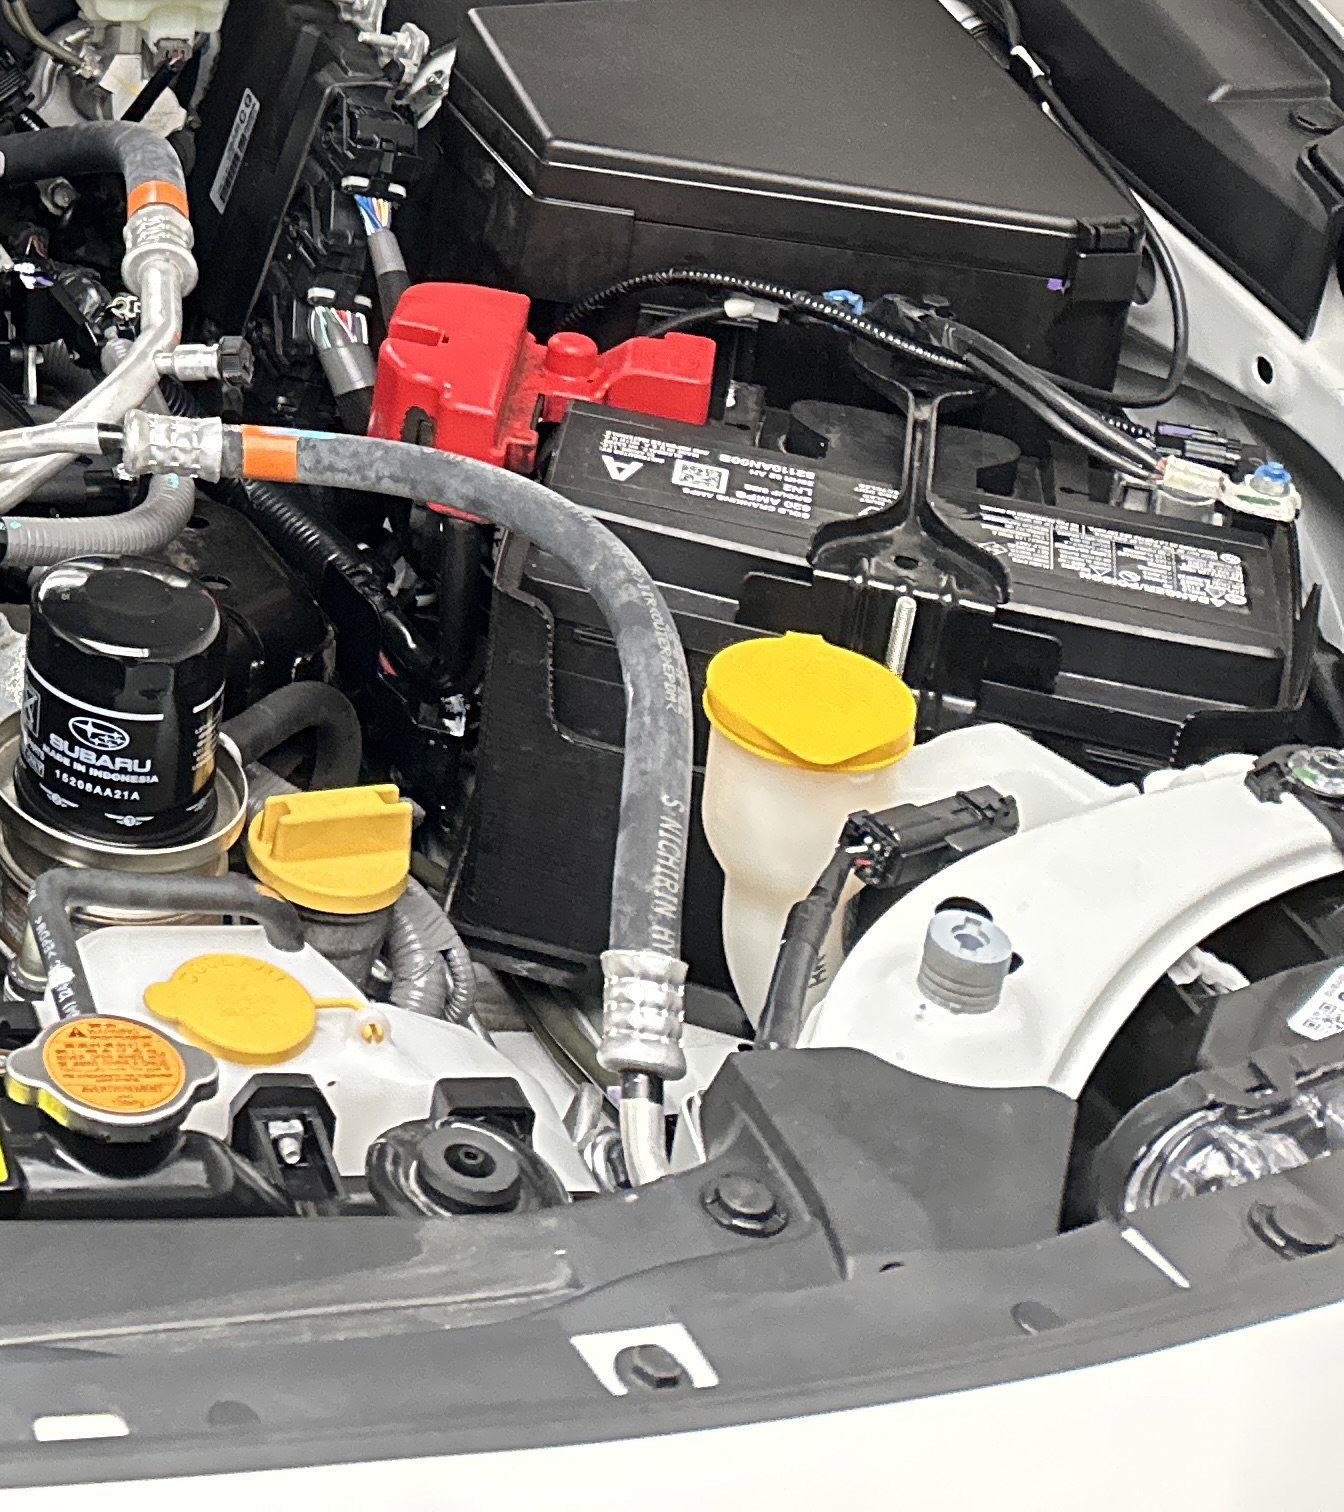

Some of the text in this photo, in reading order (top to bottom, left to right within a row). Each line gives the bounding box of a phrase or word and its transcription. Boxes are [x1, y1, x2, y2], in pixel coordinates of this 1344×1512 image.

[682, 487, 715, 499] AMPS
[735, 491, 781, 506] AMPS
[716, 494, 776, 513] CRANKING
[48, 733, 153, 774] SUBARU
[42, 744, 160, 784] MADE IN INDONESIA
